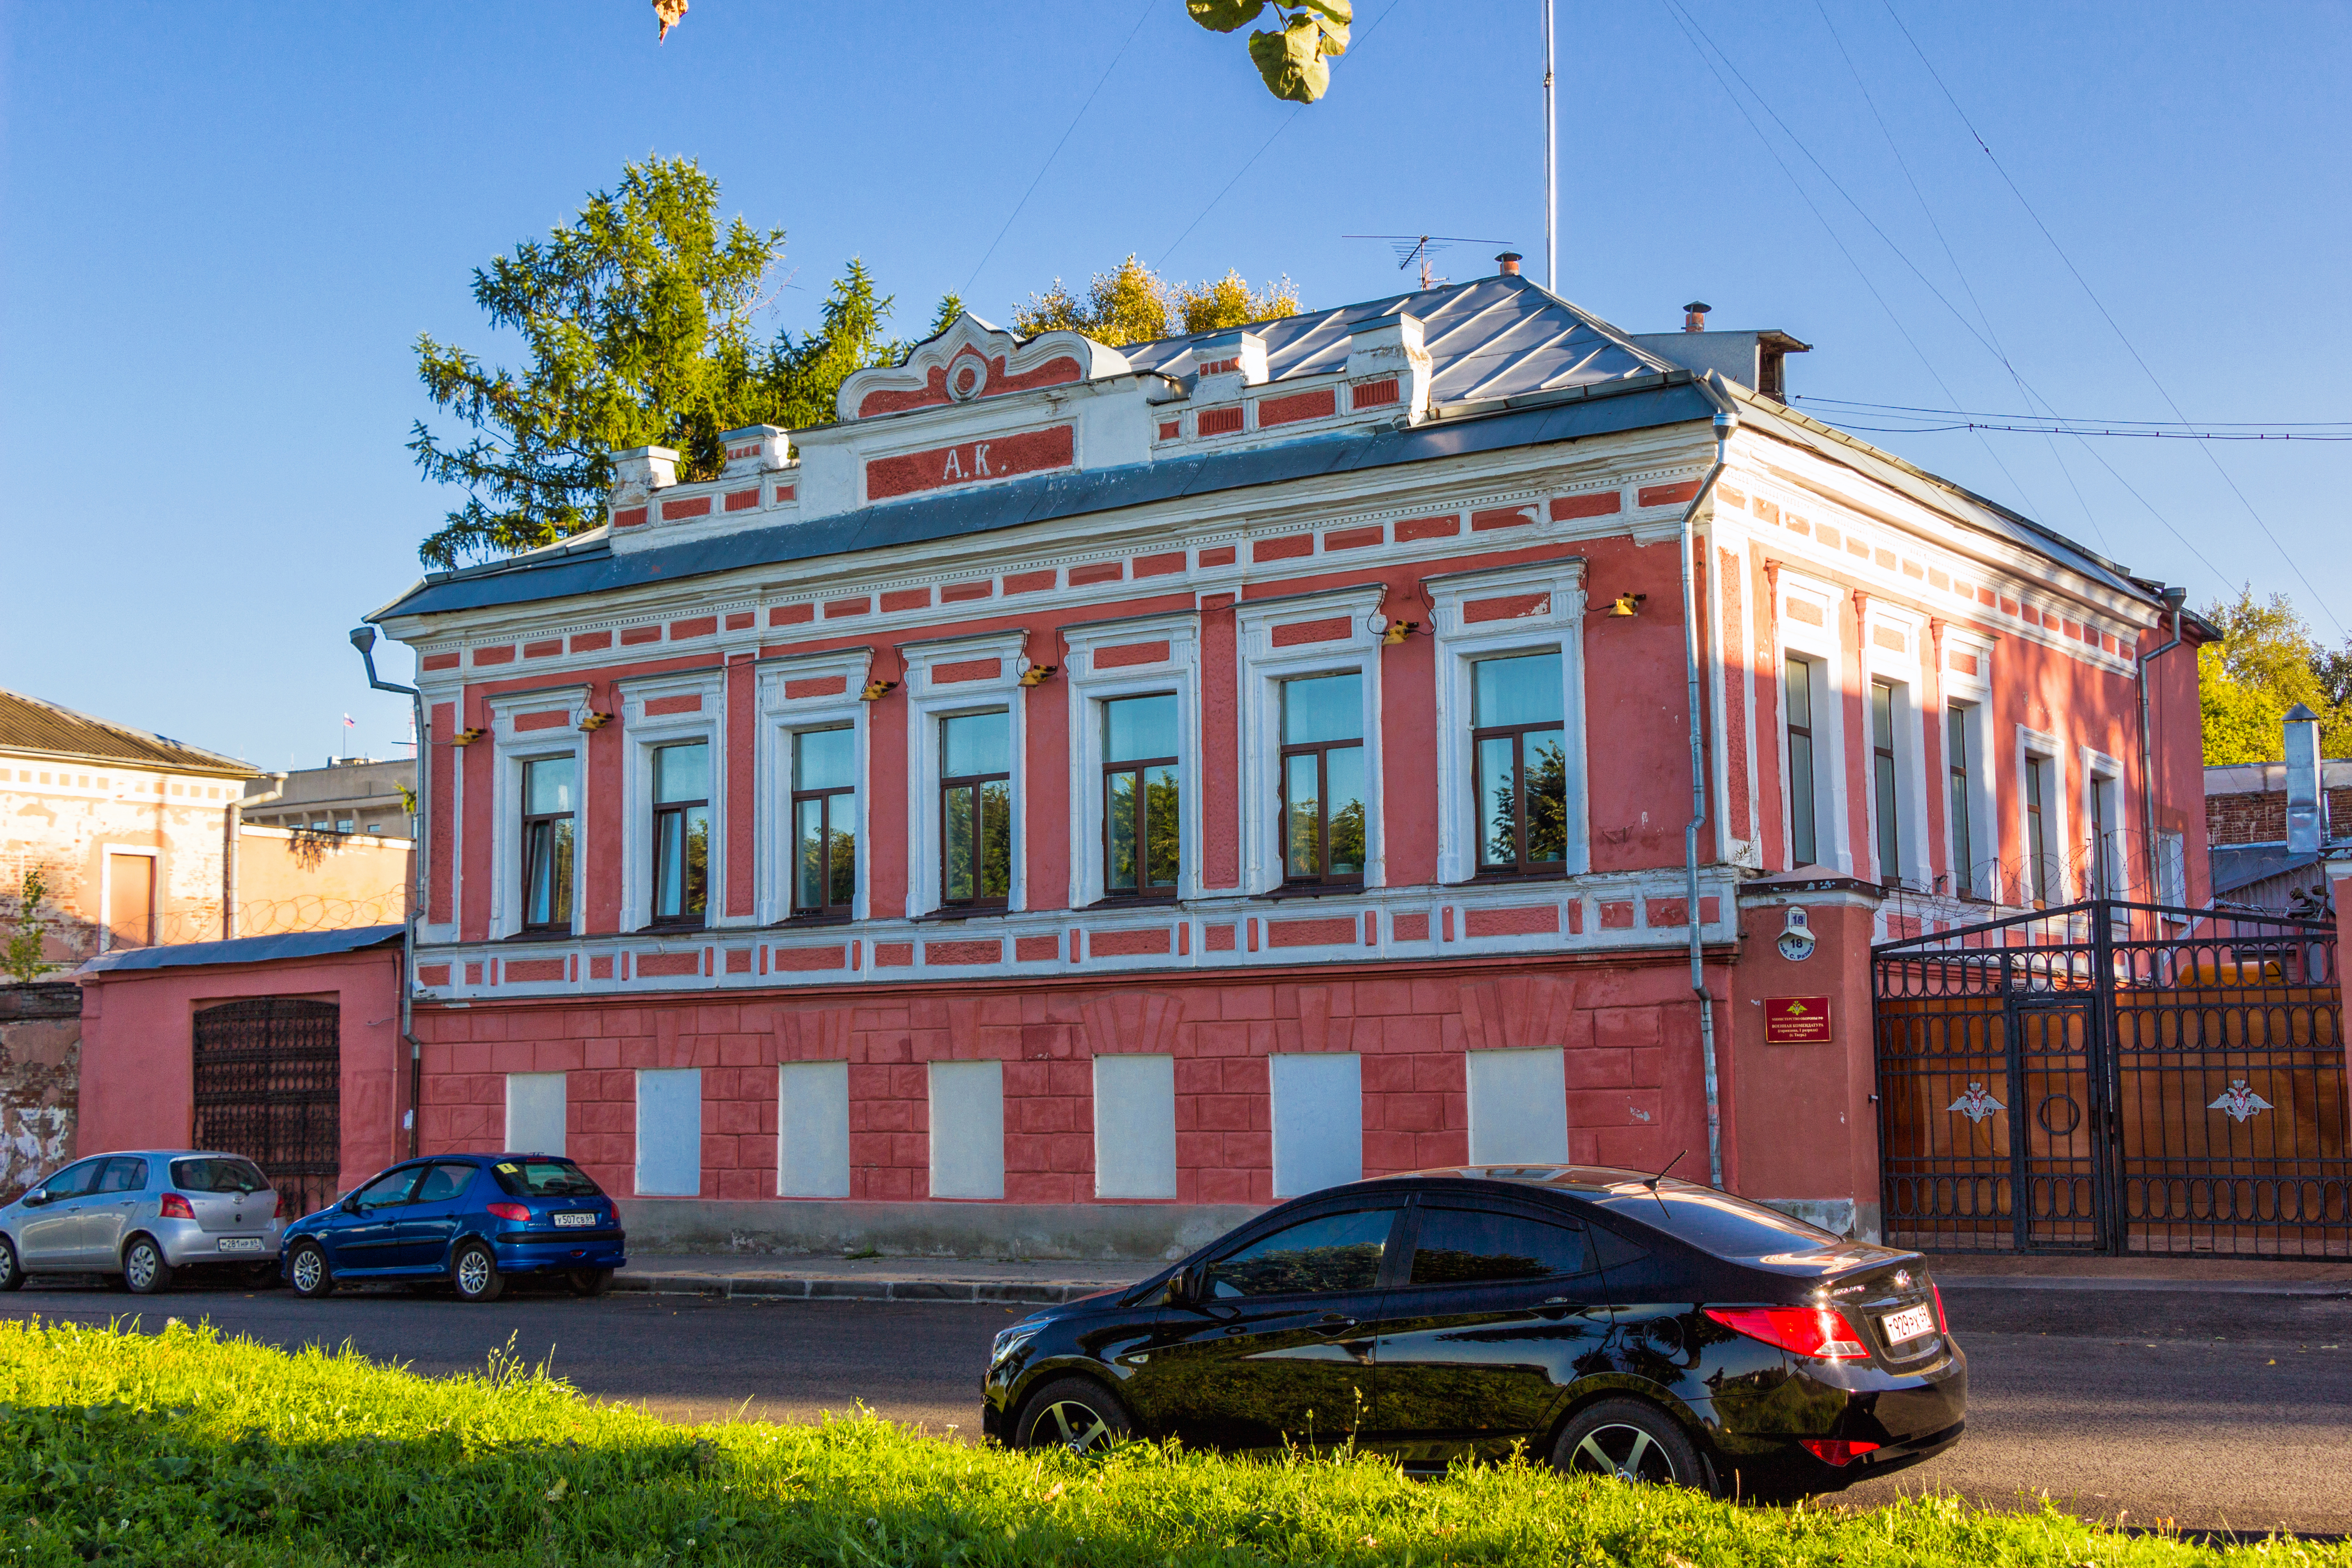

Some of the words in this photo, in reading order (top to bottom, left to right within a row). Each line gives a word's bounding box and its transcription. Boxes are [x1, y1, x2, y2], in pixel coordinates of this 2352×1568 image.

[1793, 915, 1803, 924] 18
[1790, 938, 1803, 948] 18
[1779, 943, 1788, 956] наб.
[1797, 942, 1814, 960] Разина
